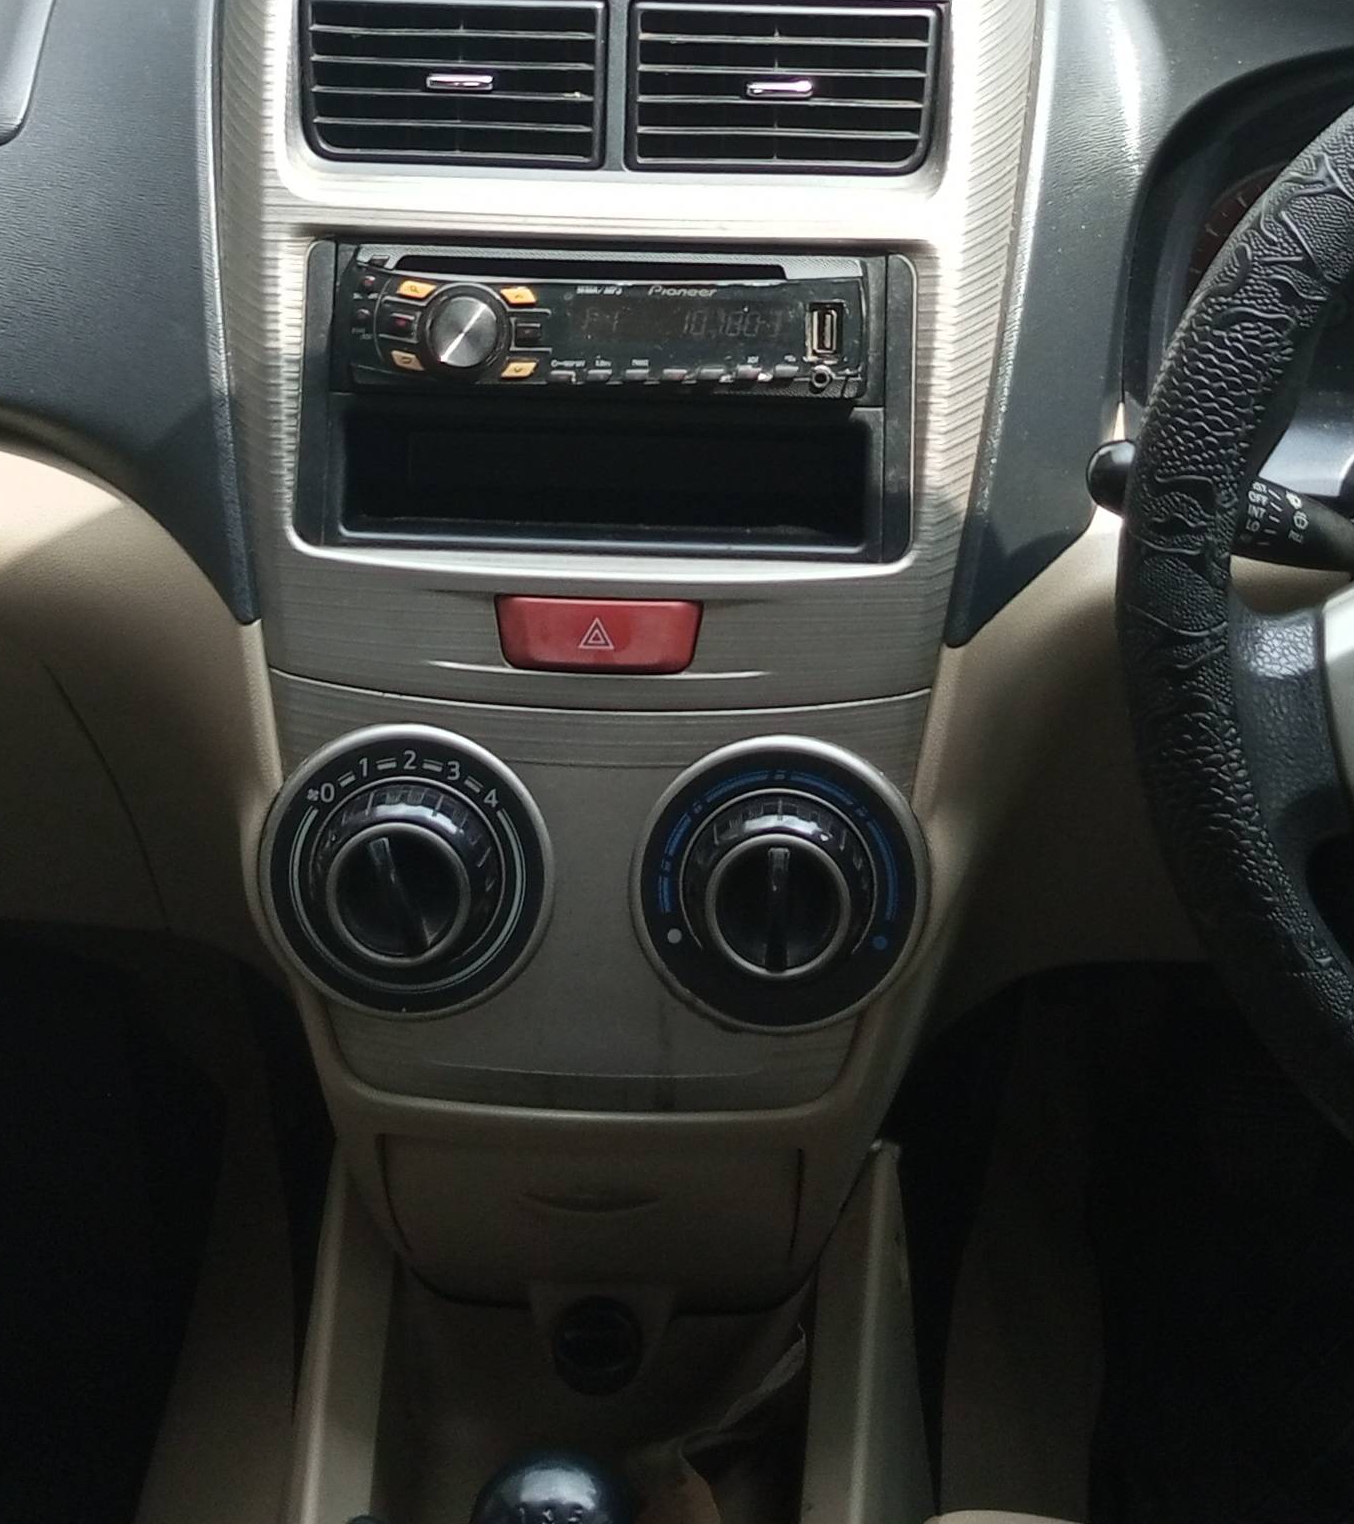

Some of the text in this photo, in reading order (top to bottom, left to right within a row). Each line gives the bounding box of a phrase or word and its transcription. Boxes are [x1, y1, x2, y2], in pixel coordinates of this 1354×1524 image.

[648, 284, 718, 297] Pioneer
[1245, 519, 1260, 532] LO
[320, 750, 498, 808] 0 1 2 3 4
